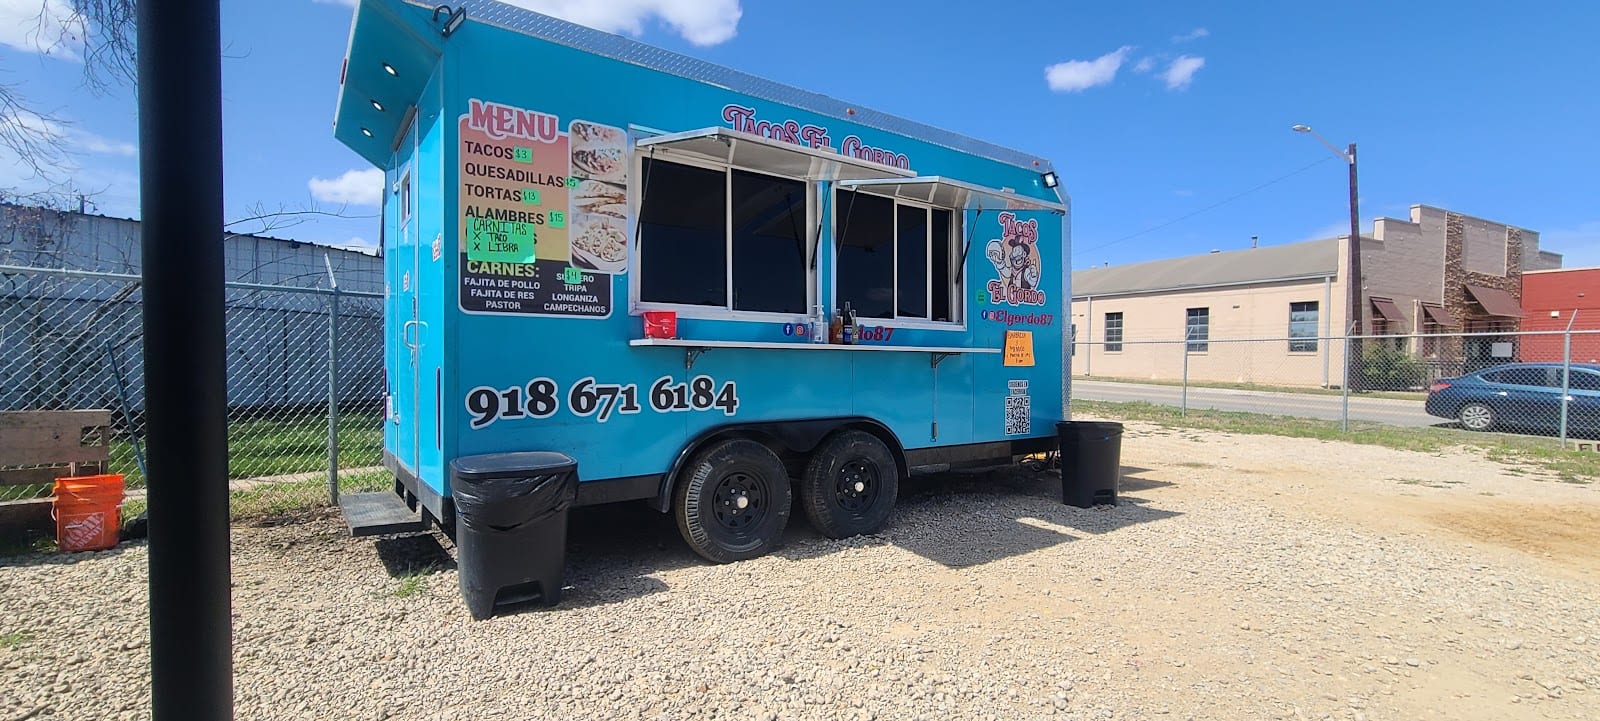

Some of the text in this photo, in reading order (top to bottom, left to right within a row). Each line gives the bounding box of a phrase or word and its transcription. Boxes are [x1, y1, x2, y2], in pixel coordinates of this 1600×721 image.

[470, 99, 557, 142] MENU
[723, 105, 800, 146] TACOS
[843, 136, 909, 170] GORDO
[465, 141, 513, 160] TACOS
[515, 148, 527, 160] $3
[465, 162, 564, 188] QUESADILLAS
[465, 183, 521, 202] TORTAS
[523, 190, 536, 202] $13
[465, 205, 545, 225] ALAMBRES
[549, 211, 564, 223] $15
[473, 218, 527, 236] CARNITAS
[999, 212, 1037, 245] TACOS
[486, 232, 508, 243] TACO
[488, 241, 519, 253] LIBRA
[466, 260, 540, 278] CARNES:
[464, 277, 541, 290] FAJITA DE POLLO
[564, 284, 587, 293] TRIPA
[470, 288, 535, 300] FAJITA DE RES
[552, 293, 599, 303] LONGANIZA
[988, 280, 1046, 305] EL GORDO
[485, 300, 521, 310] PASTOR
[543, 303, 606, 313] CAMPECHANOS
[467, 376, 739, 429] 918 671 6184
